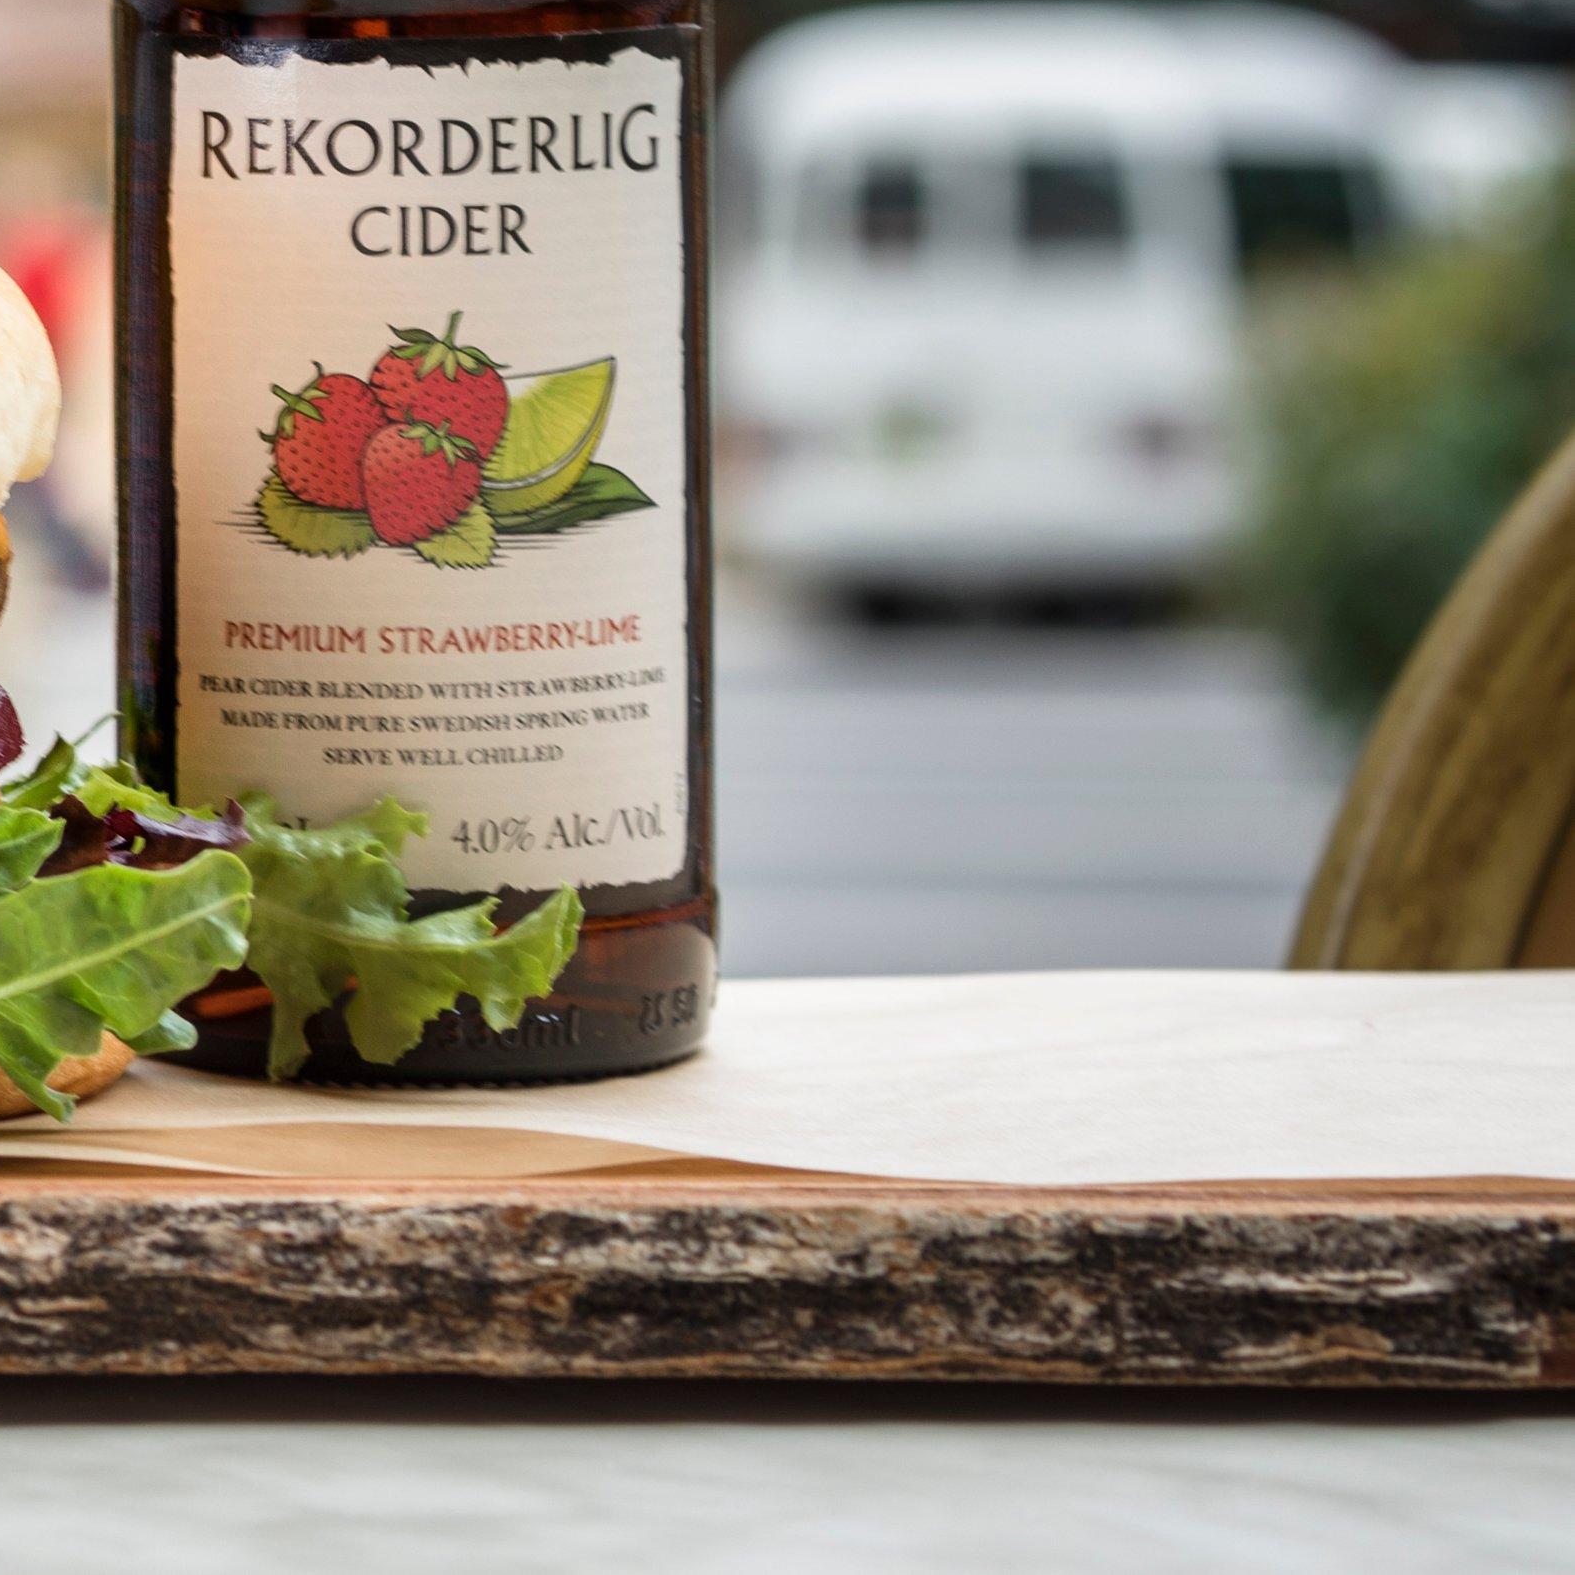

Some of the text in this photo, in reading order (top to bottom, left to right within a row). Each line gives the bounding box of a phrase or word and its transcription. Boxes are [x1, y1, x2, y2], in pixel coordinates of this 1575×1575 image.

[201, 104, 659, 179] REKORDERLIG
[350, 204, 533, 256] CIDER
[224, 614, 641, 654] PREMIUM STRAWBERRY-LIME
[199, 666, 666, 700] PEAR CIDER BLENDED WITH STRAWBERRY-LIME
[220, 702, 650, 733] MADE FROM PURE SWEDISH SPRING WATER
[323, 744, 565, 767] SERVE WELL CHILLED
[453, 814, 537, 854] 4.0%
